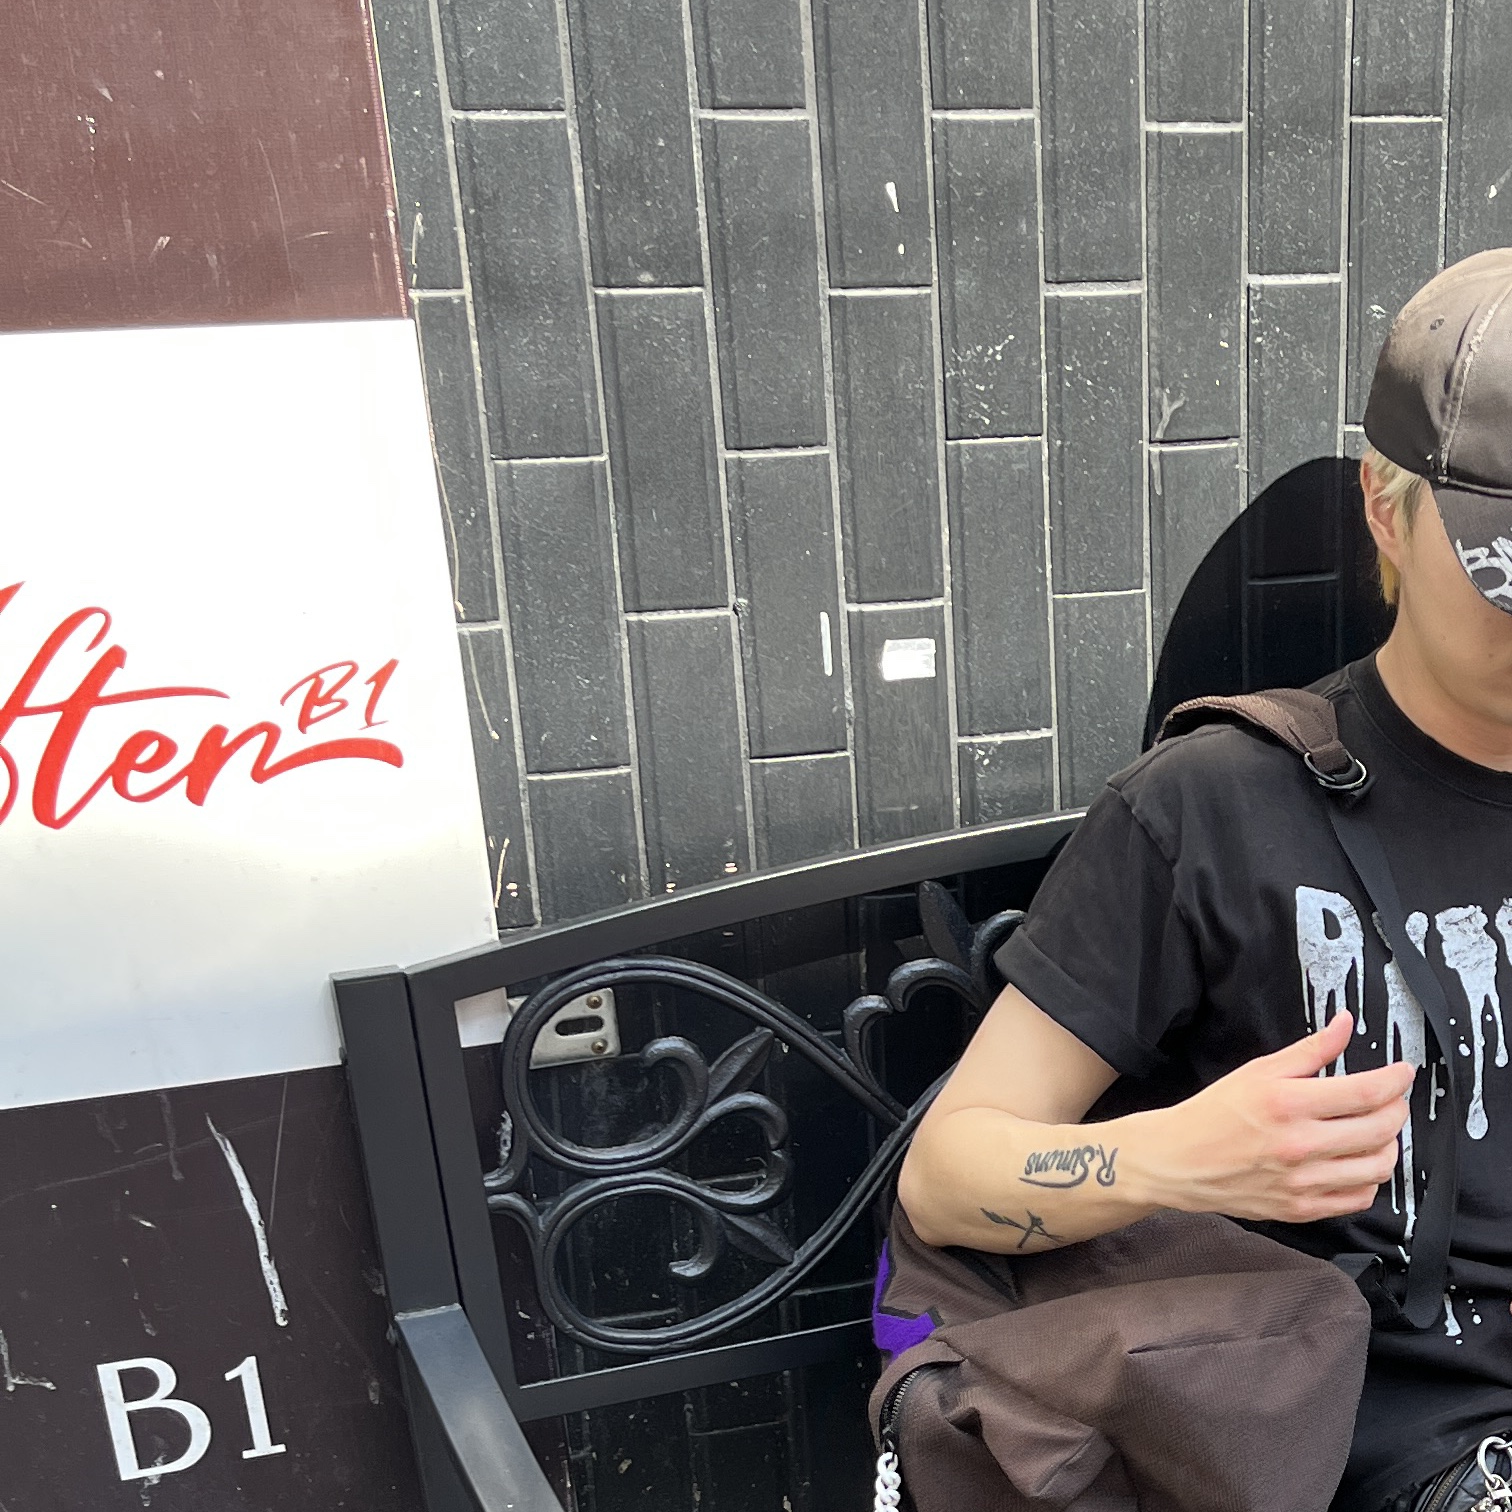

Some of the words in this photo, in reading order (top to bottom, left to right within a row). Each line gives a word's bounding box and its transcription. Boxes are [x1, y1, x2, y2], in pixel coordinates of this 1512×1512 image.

[0, 581, 403, 830] ften
[280, 658, 400, 734] B1
[96, 1355, 287, 1482] B1
